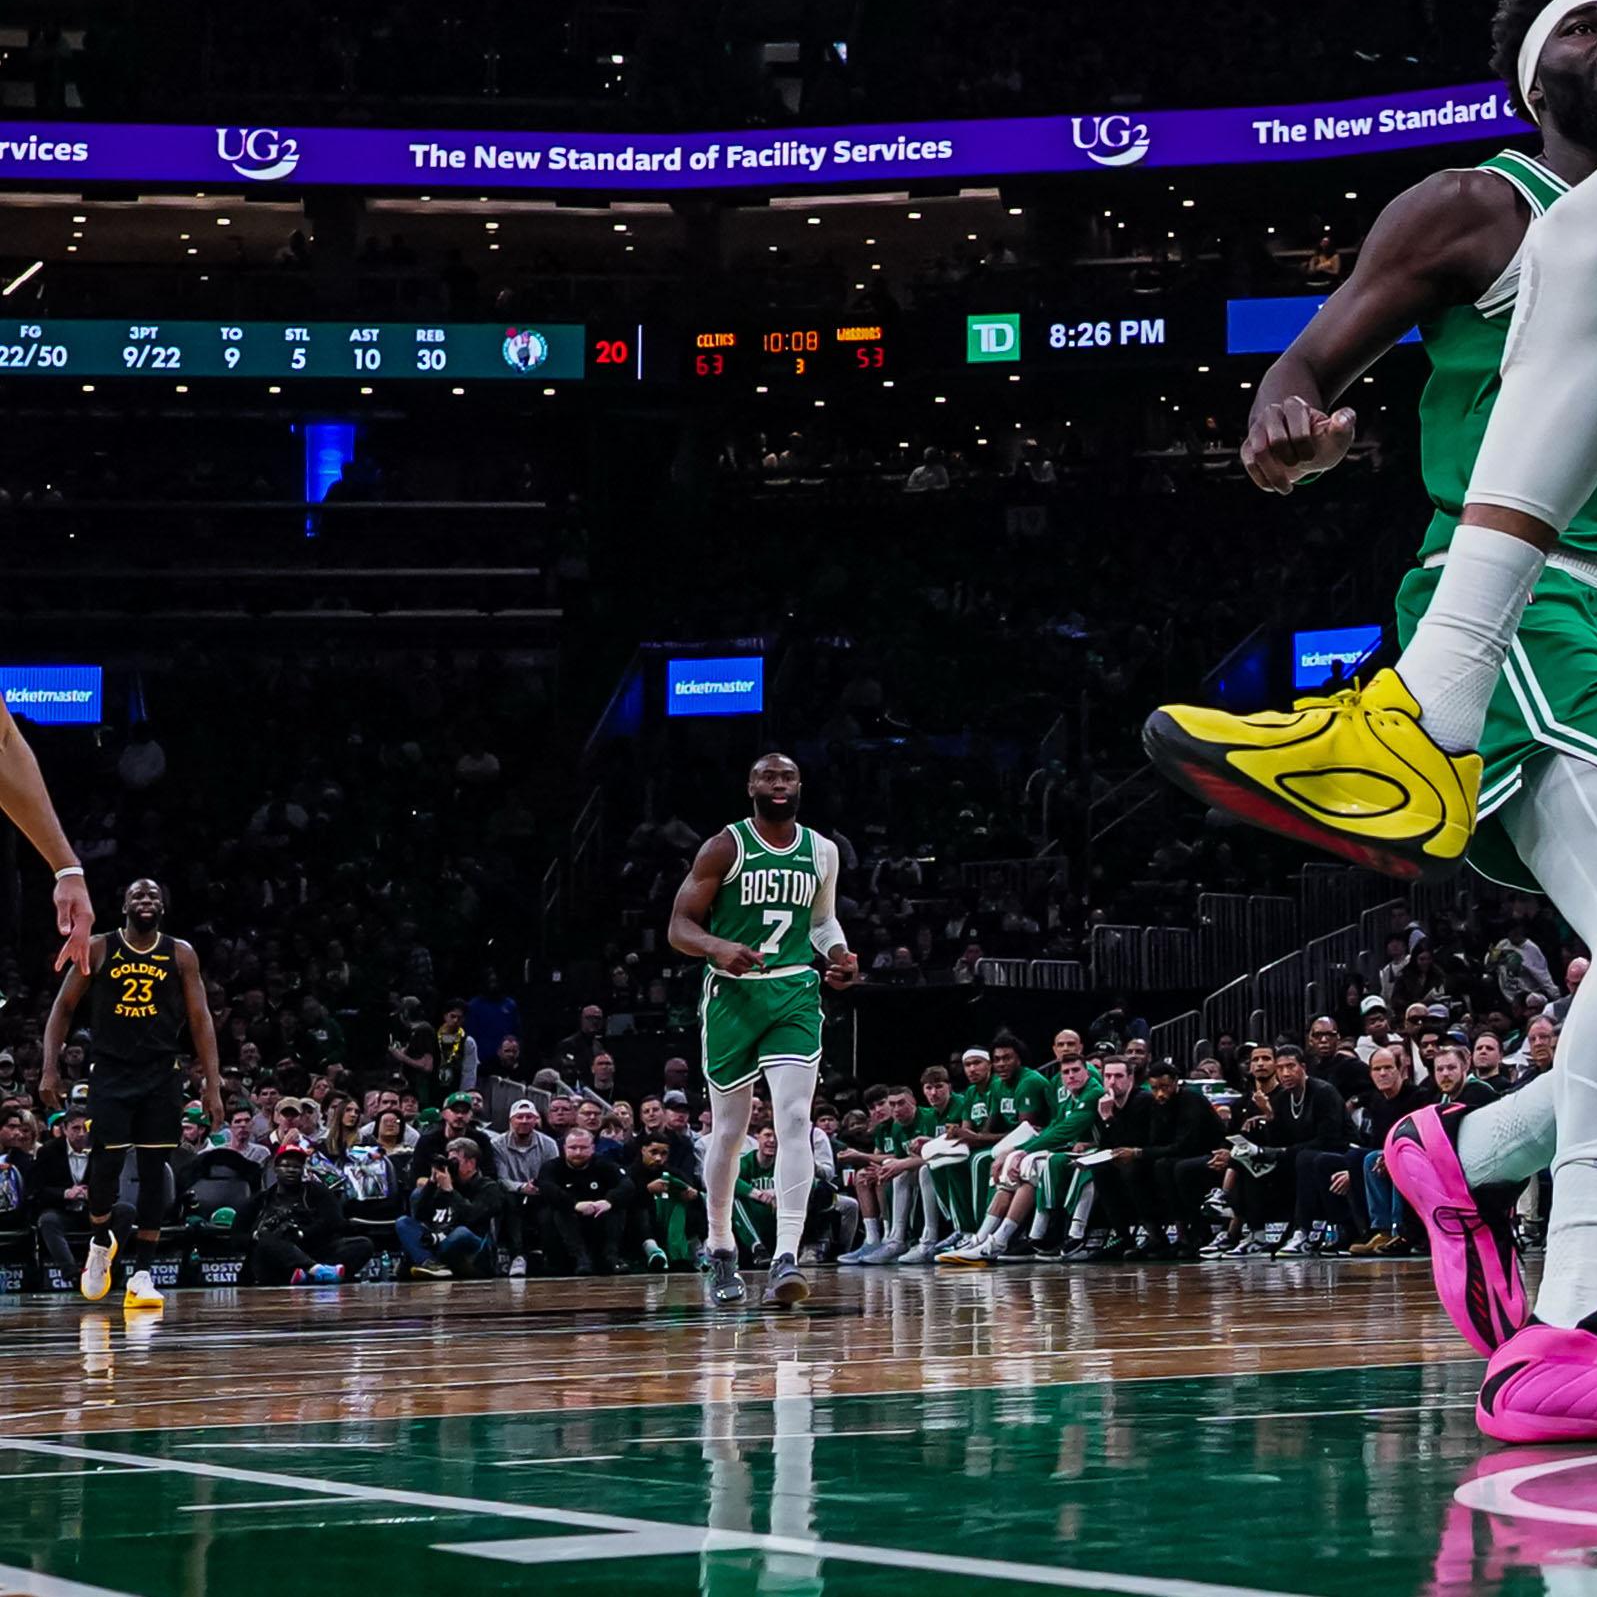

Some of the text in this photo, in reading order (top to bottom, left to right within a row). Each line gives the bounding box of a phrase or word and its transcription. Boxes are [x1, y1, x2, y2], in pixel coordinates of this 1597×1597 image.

[1252, 119, 1307, 144] The
[1314, 113, 1371, 140] New
[1379, 94, 1498, 134] Standard
[1071, 115, 1150, 150] UG2
[0, 135, 88, 161] rvices
[216, 128, 300, 162] UG2
[409, 136, 953, 172] The New Standard of Facility Services
[20, 325, 445, 342] FG 3PT TO STL AST REB
[696, 332, 735, 348] CELTICS
[764, 331, 818, 352] 10:08
[973, 323, 1014, 353] TD
[1050, 319, 1164, 348] 8:26 PM
[123, 345, 181, 368] 9/22
[224, 348, 240, 368] 9
[291, 348, 306, 369] 5
[354, 349, 381, 370] 10
[417, 349, 446, 370] 30
[596, 340, 628, 364] 20
[856, 347, 884, 369] 53
[795, 358, 805, 375] 3
[5, 687, 93, 703] ticketmaster
[675, 680, 755, 695] ticketmaster
[741, 869, 817, 908] BOSTON
[760, 909, 793, 954] 7
[110, 962, 168, 981] GOLDEN
[121, 978, 154, 1003] 23
[114, 1002, 158, 1018] STATE
[201, 1262, 243, 1273] BOSTO
[205, 1273, 238, 1283] CELTI
